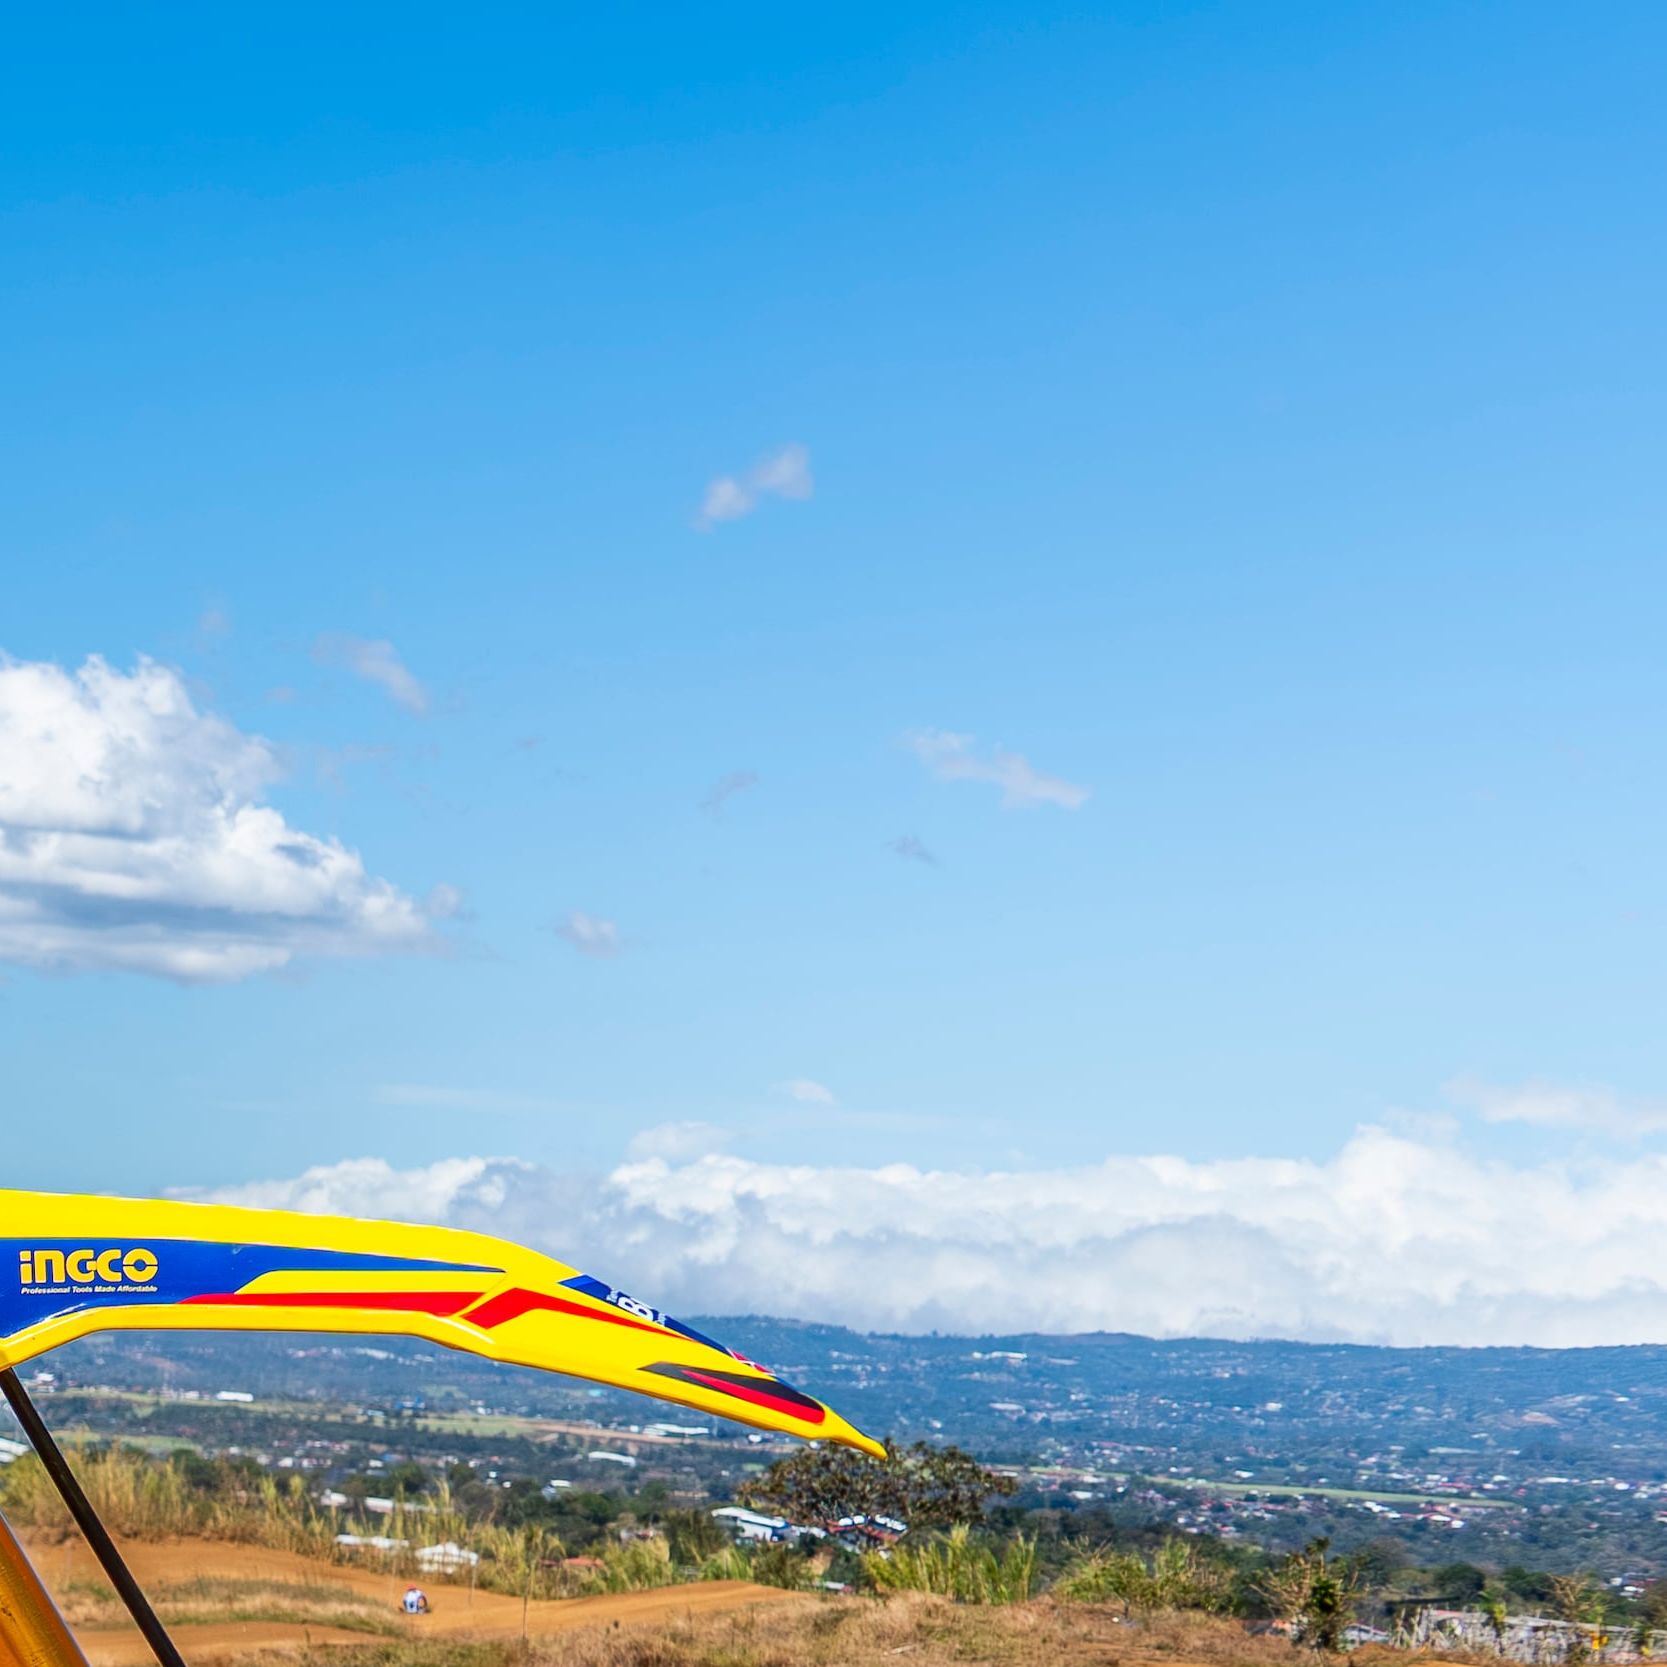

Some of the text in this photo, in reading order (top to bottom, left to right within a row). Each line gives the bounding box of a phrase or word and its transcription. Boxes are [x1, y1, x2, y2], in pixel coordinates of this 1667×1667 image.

[20, 1284, 158, 1295] Professional Tools Made Affordable
